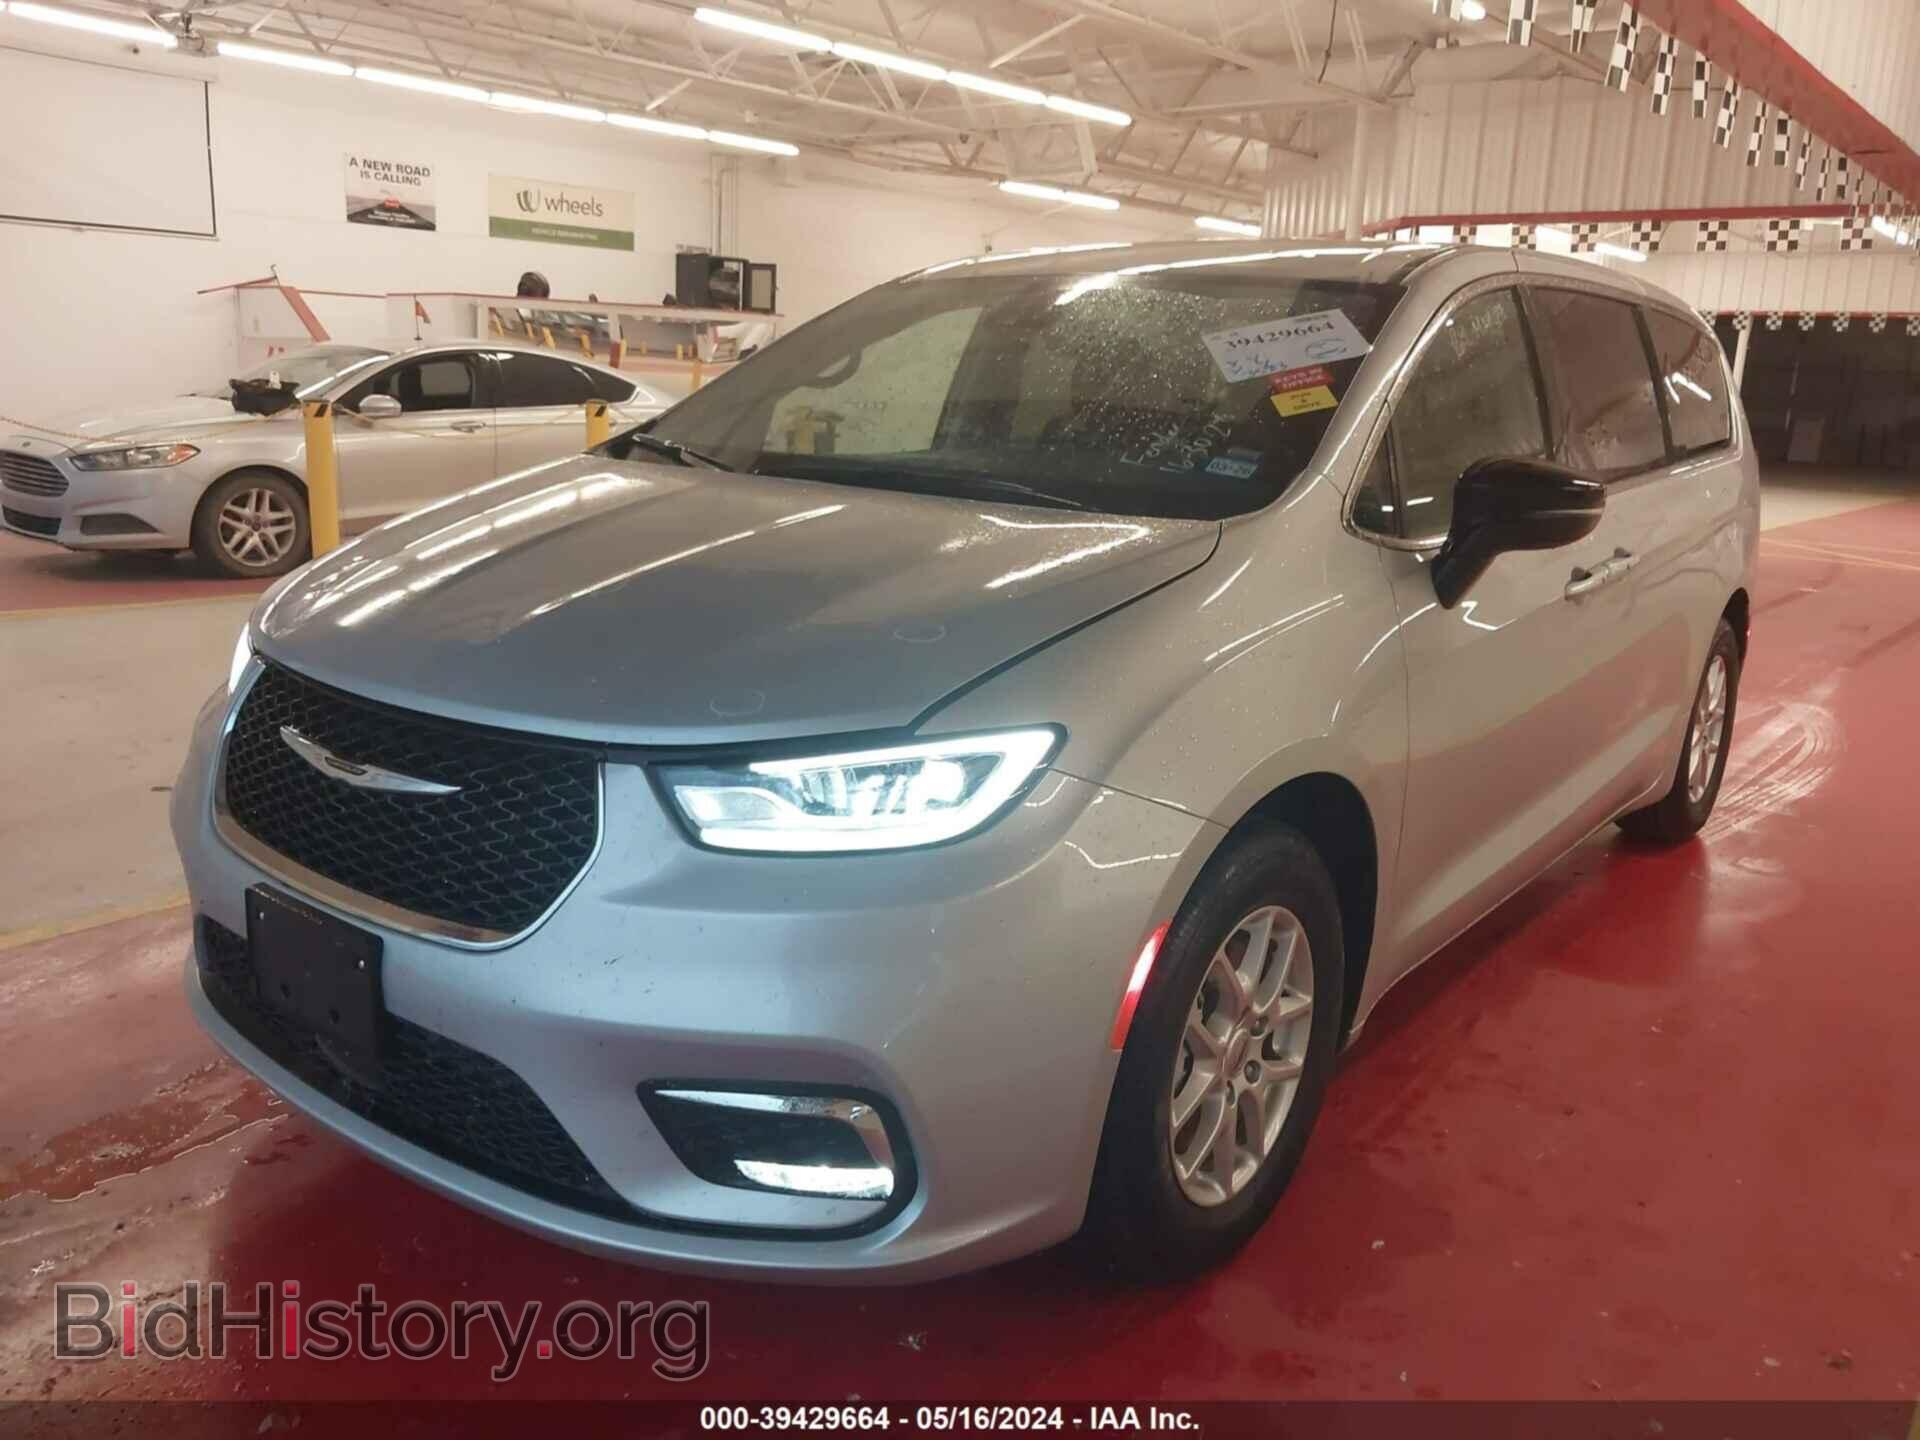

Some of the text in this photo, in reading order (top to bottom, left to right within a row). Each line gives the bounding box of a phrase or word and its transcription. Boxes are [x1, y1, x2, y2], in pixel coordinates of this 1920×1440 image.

[350, 157, 431, 177] A NEW ROAD
[360, 170, 422, 186] IS CALLING
[544, 191, 604, 217] wheels
[1224, 321, 1335, 349] 39429664
